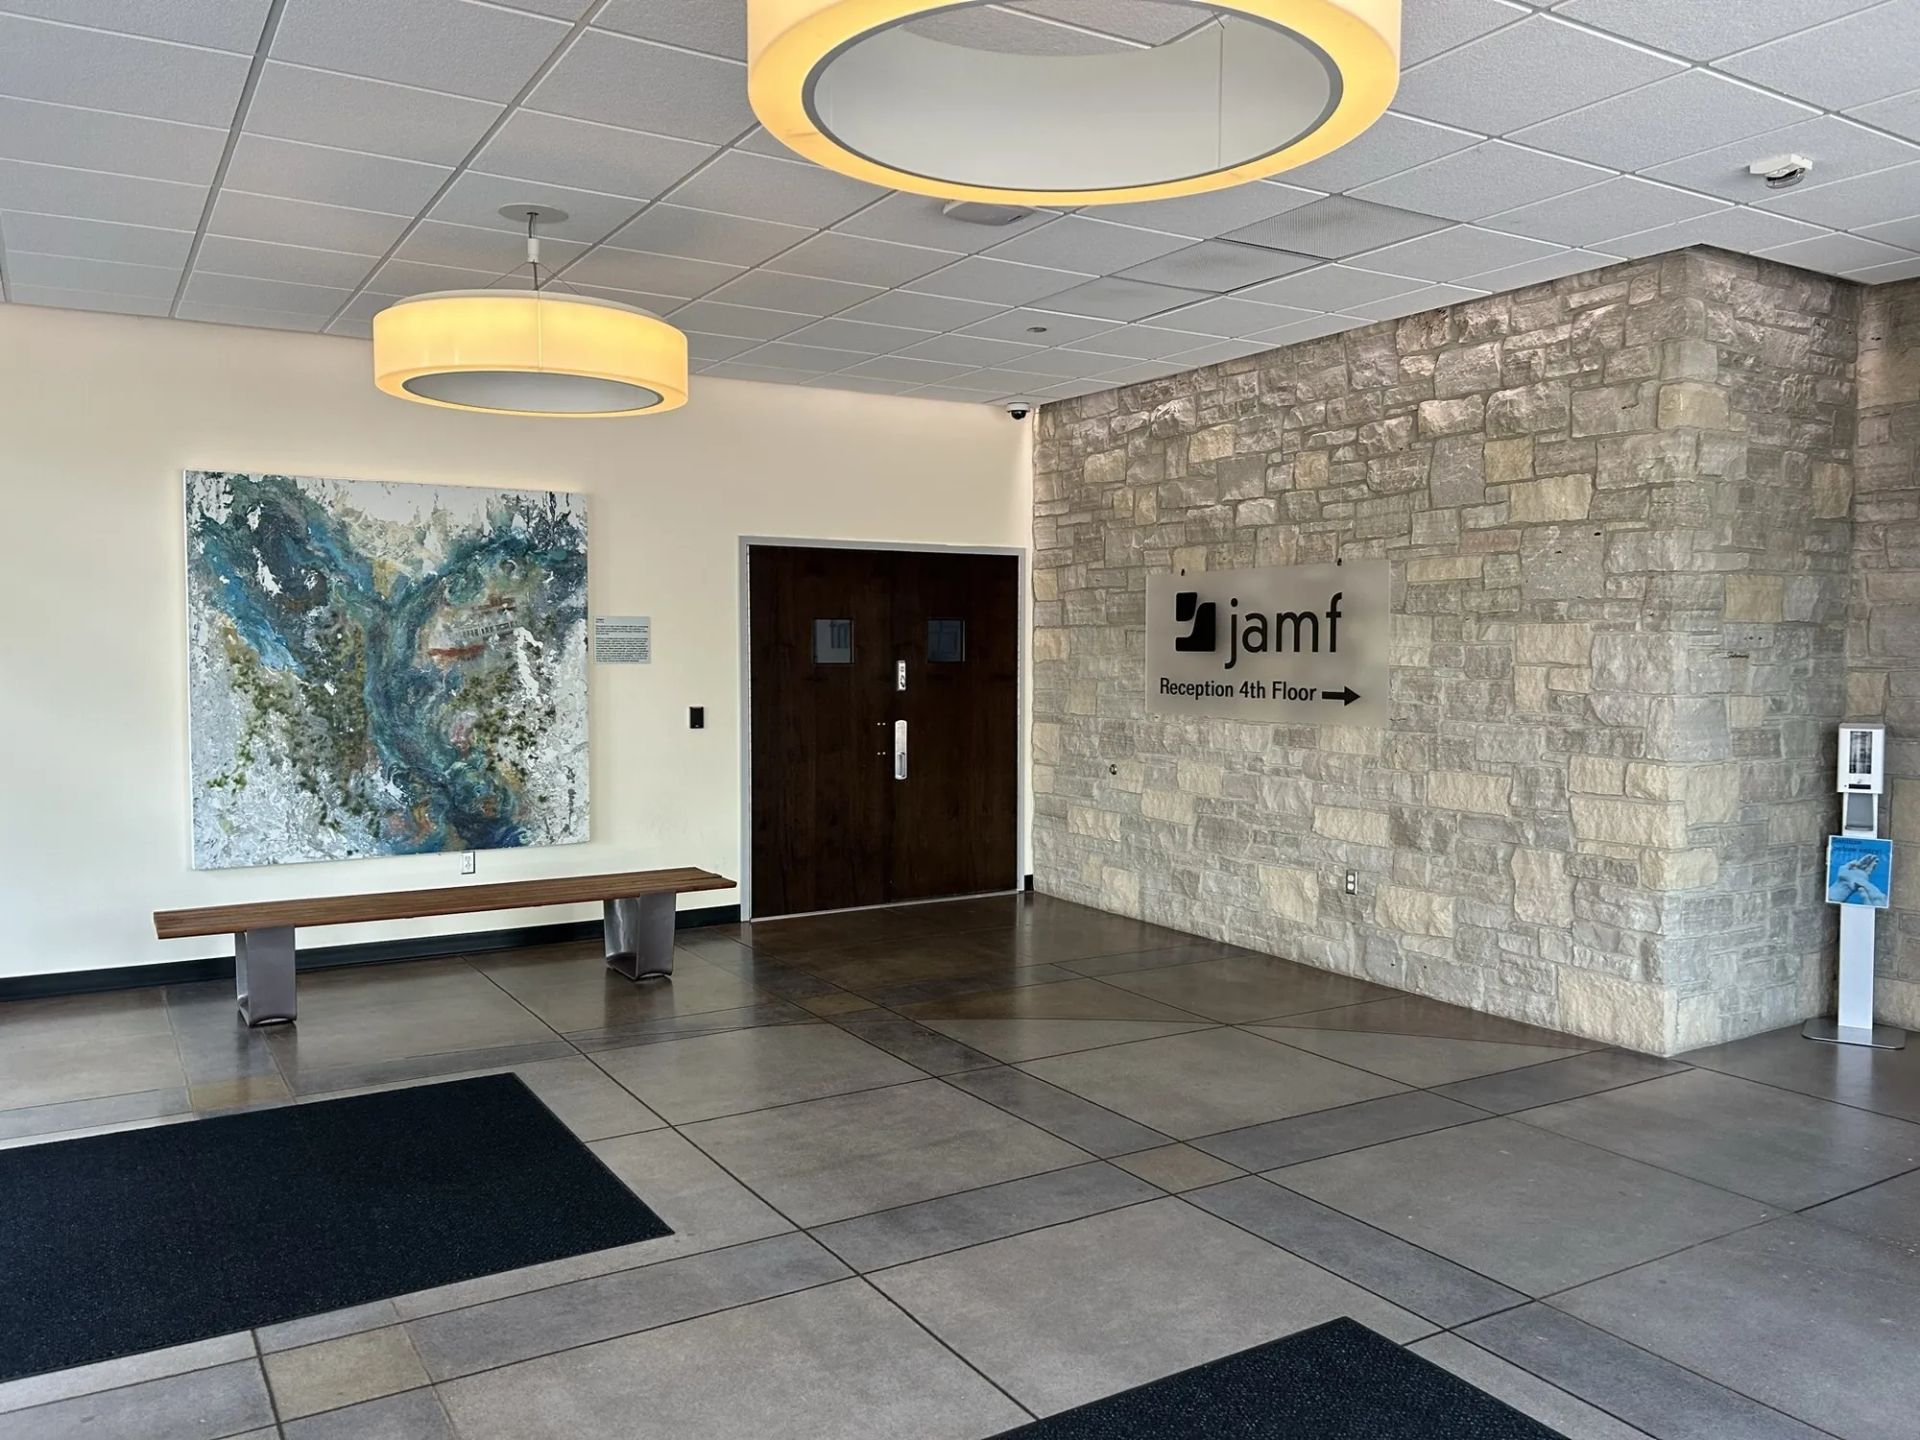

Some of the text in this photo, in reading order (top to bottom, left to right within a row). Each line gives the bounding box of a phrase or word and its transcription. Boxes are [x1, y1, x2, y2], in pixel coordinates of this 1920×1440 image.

[1224, 591, 1343, 670] jamf
[1160, 677, 1317, 701] Reception 4th Floor
